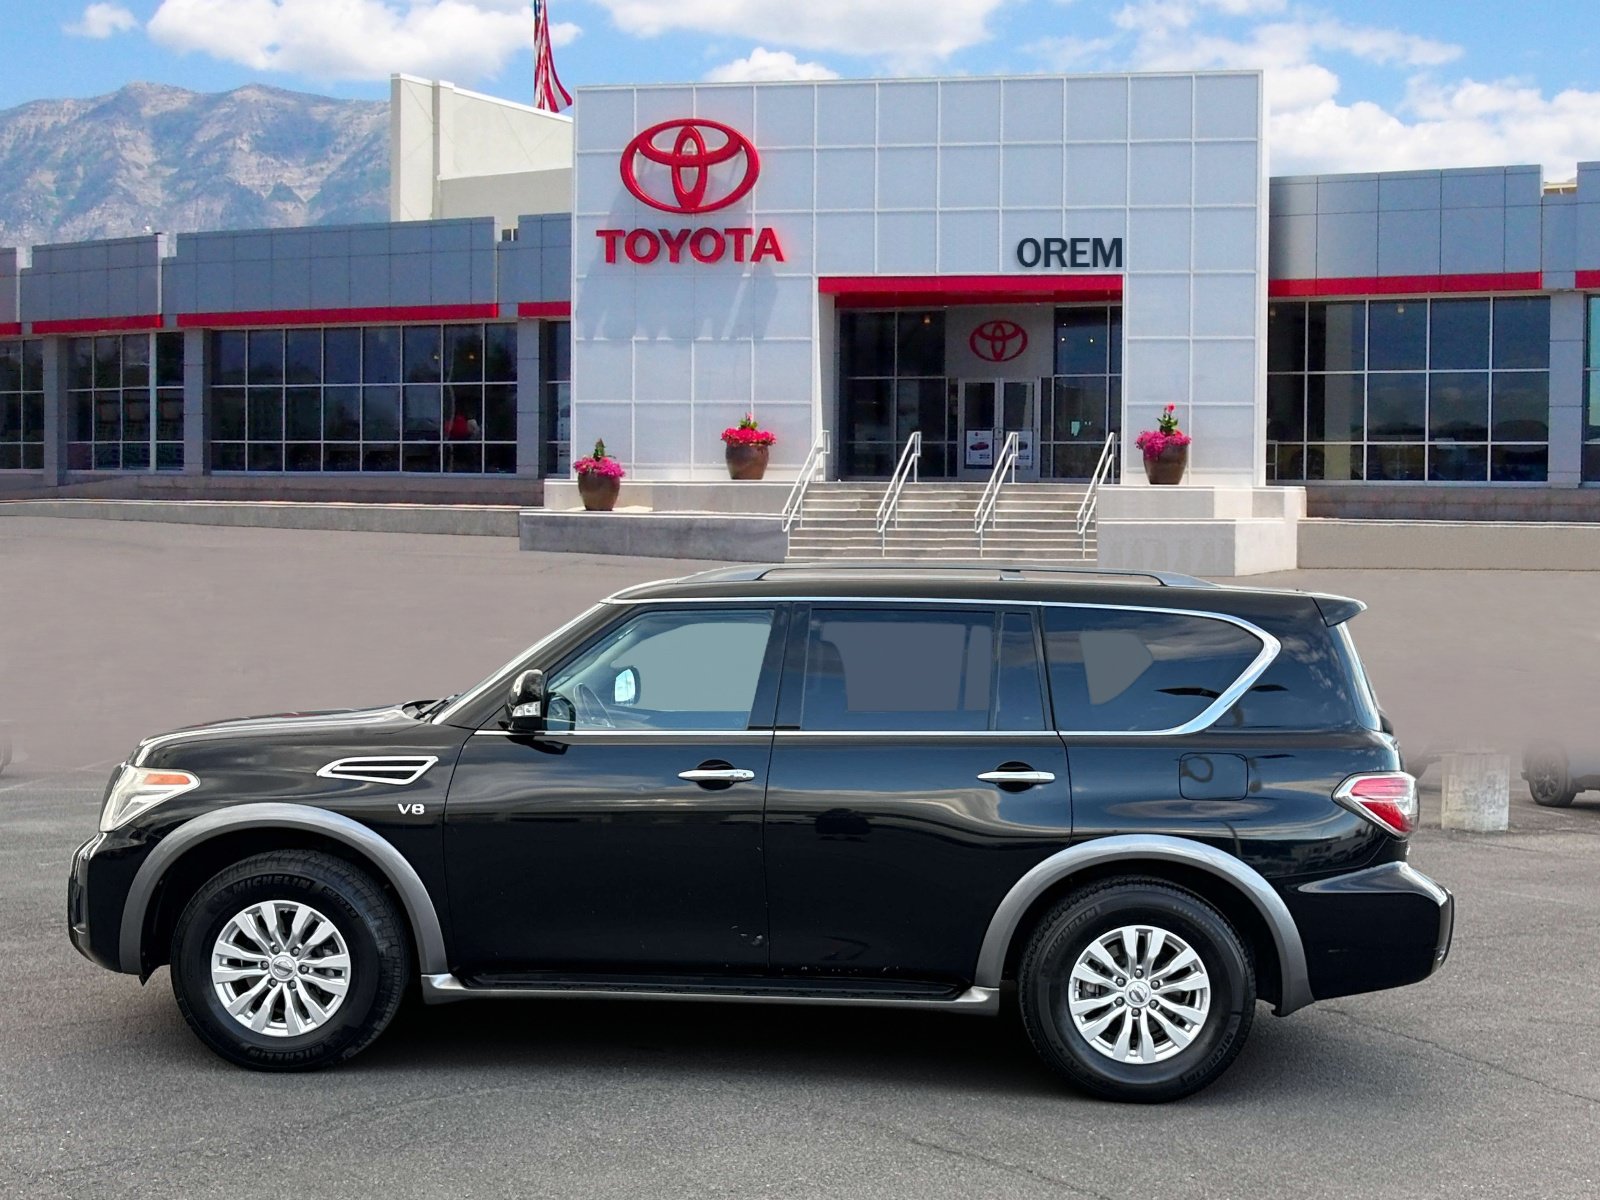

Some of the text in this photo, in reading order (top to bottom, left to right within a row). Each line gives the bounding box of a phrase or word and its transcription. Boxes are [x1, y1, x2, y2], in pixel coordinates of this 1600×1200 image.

[595, 227, 785, 264] TOYOTA
[1016, 237, 1123, 268] OREM
[397, 803, 425, 815] V8
[233, 874, 311, 893] MICHELIN
